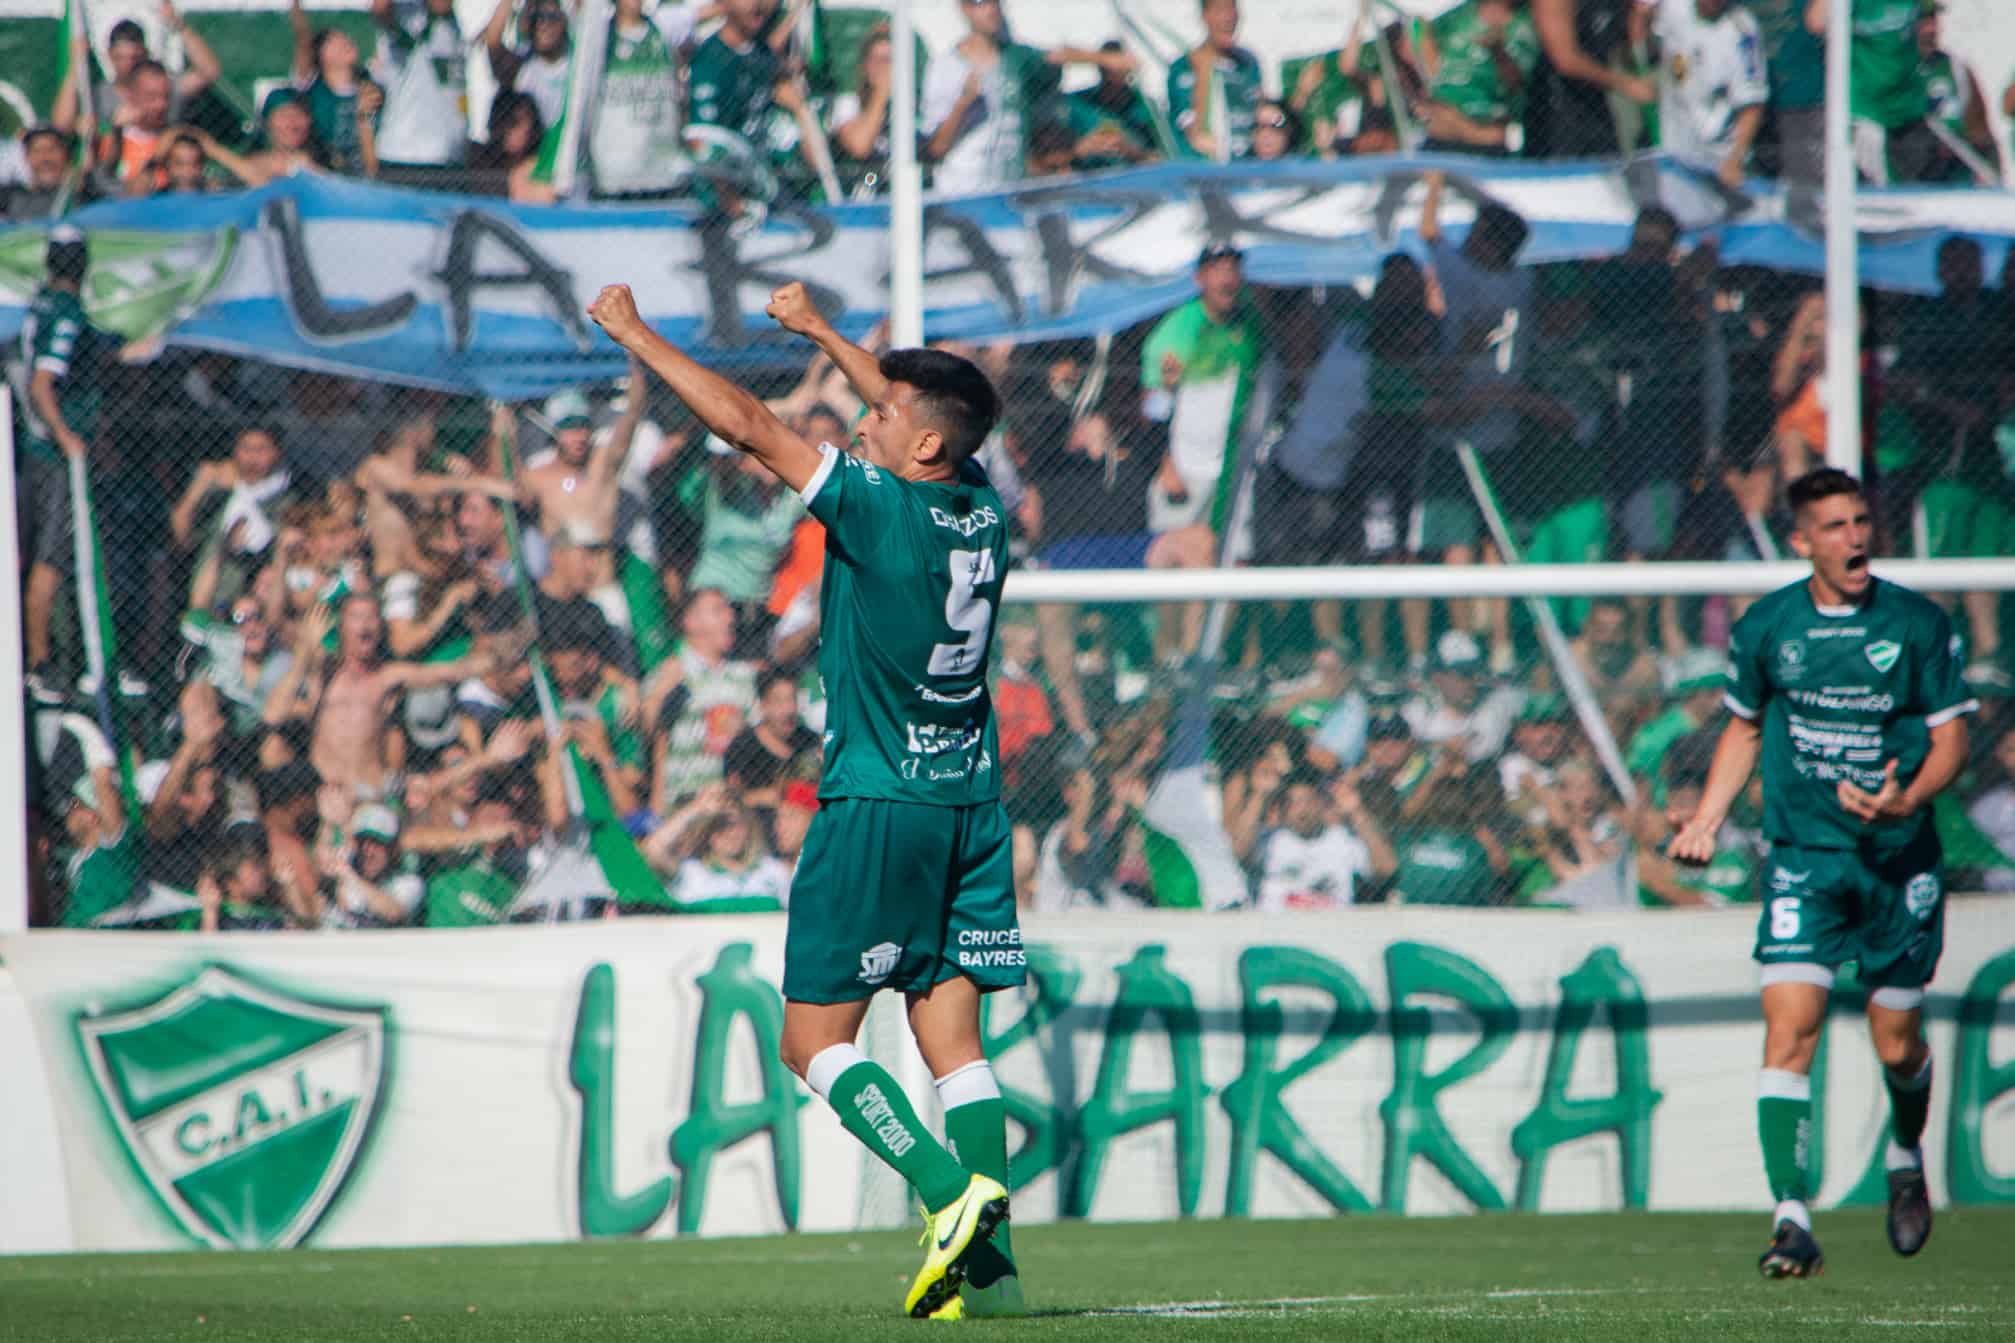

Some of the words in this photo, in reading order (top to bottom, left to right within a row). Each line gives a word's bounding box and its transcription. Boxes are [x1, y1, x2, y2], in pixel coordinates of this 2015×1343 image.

[264, 197, 590, 352] LA
[927, 547, 995, 676] 5
[958, 929, 1024, 946] CRUCE
[958, 950, 1027, 967] BAYRES
[1770, 896, 1800, 940] 6
[175, 1069, 333, 1157] C.A.I.
[570, 941, 811, 1236] LA
[980, 941, 1664, 1222] BARRA
